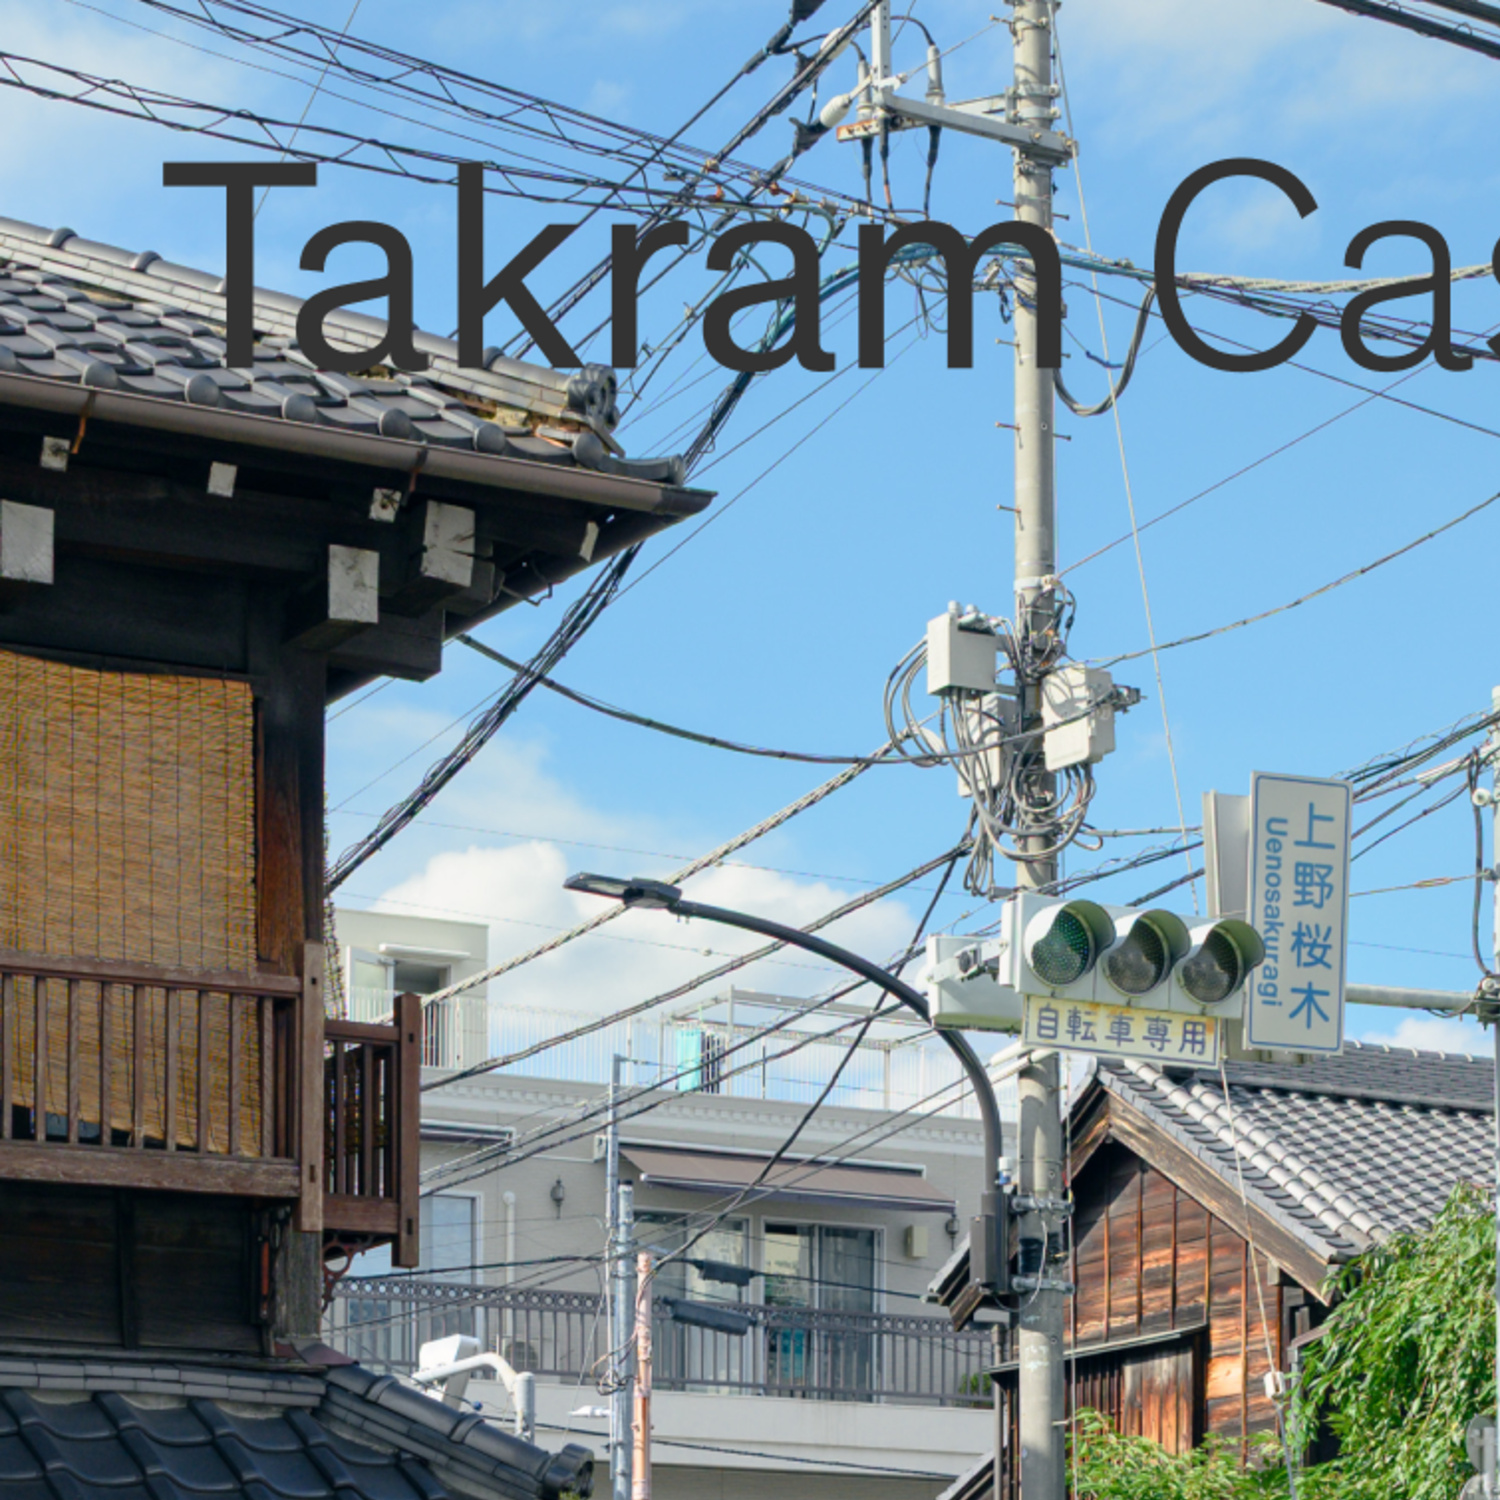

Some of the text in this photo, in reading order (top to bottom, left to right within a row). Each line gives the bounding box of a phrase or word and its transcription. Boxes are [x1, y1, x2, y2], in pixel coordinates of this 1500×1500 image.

[1257, 816, 1288, 1006] Uenosakuragi
[1288, 802, 1336, 1029] 上野桜木
[1036, 1003, 1207, 1056] 自転車専用
